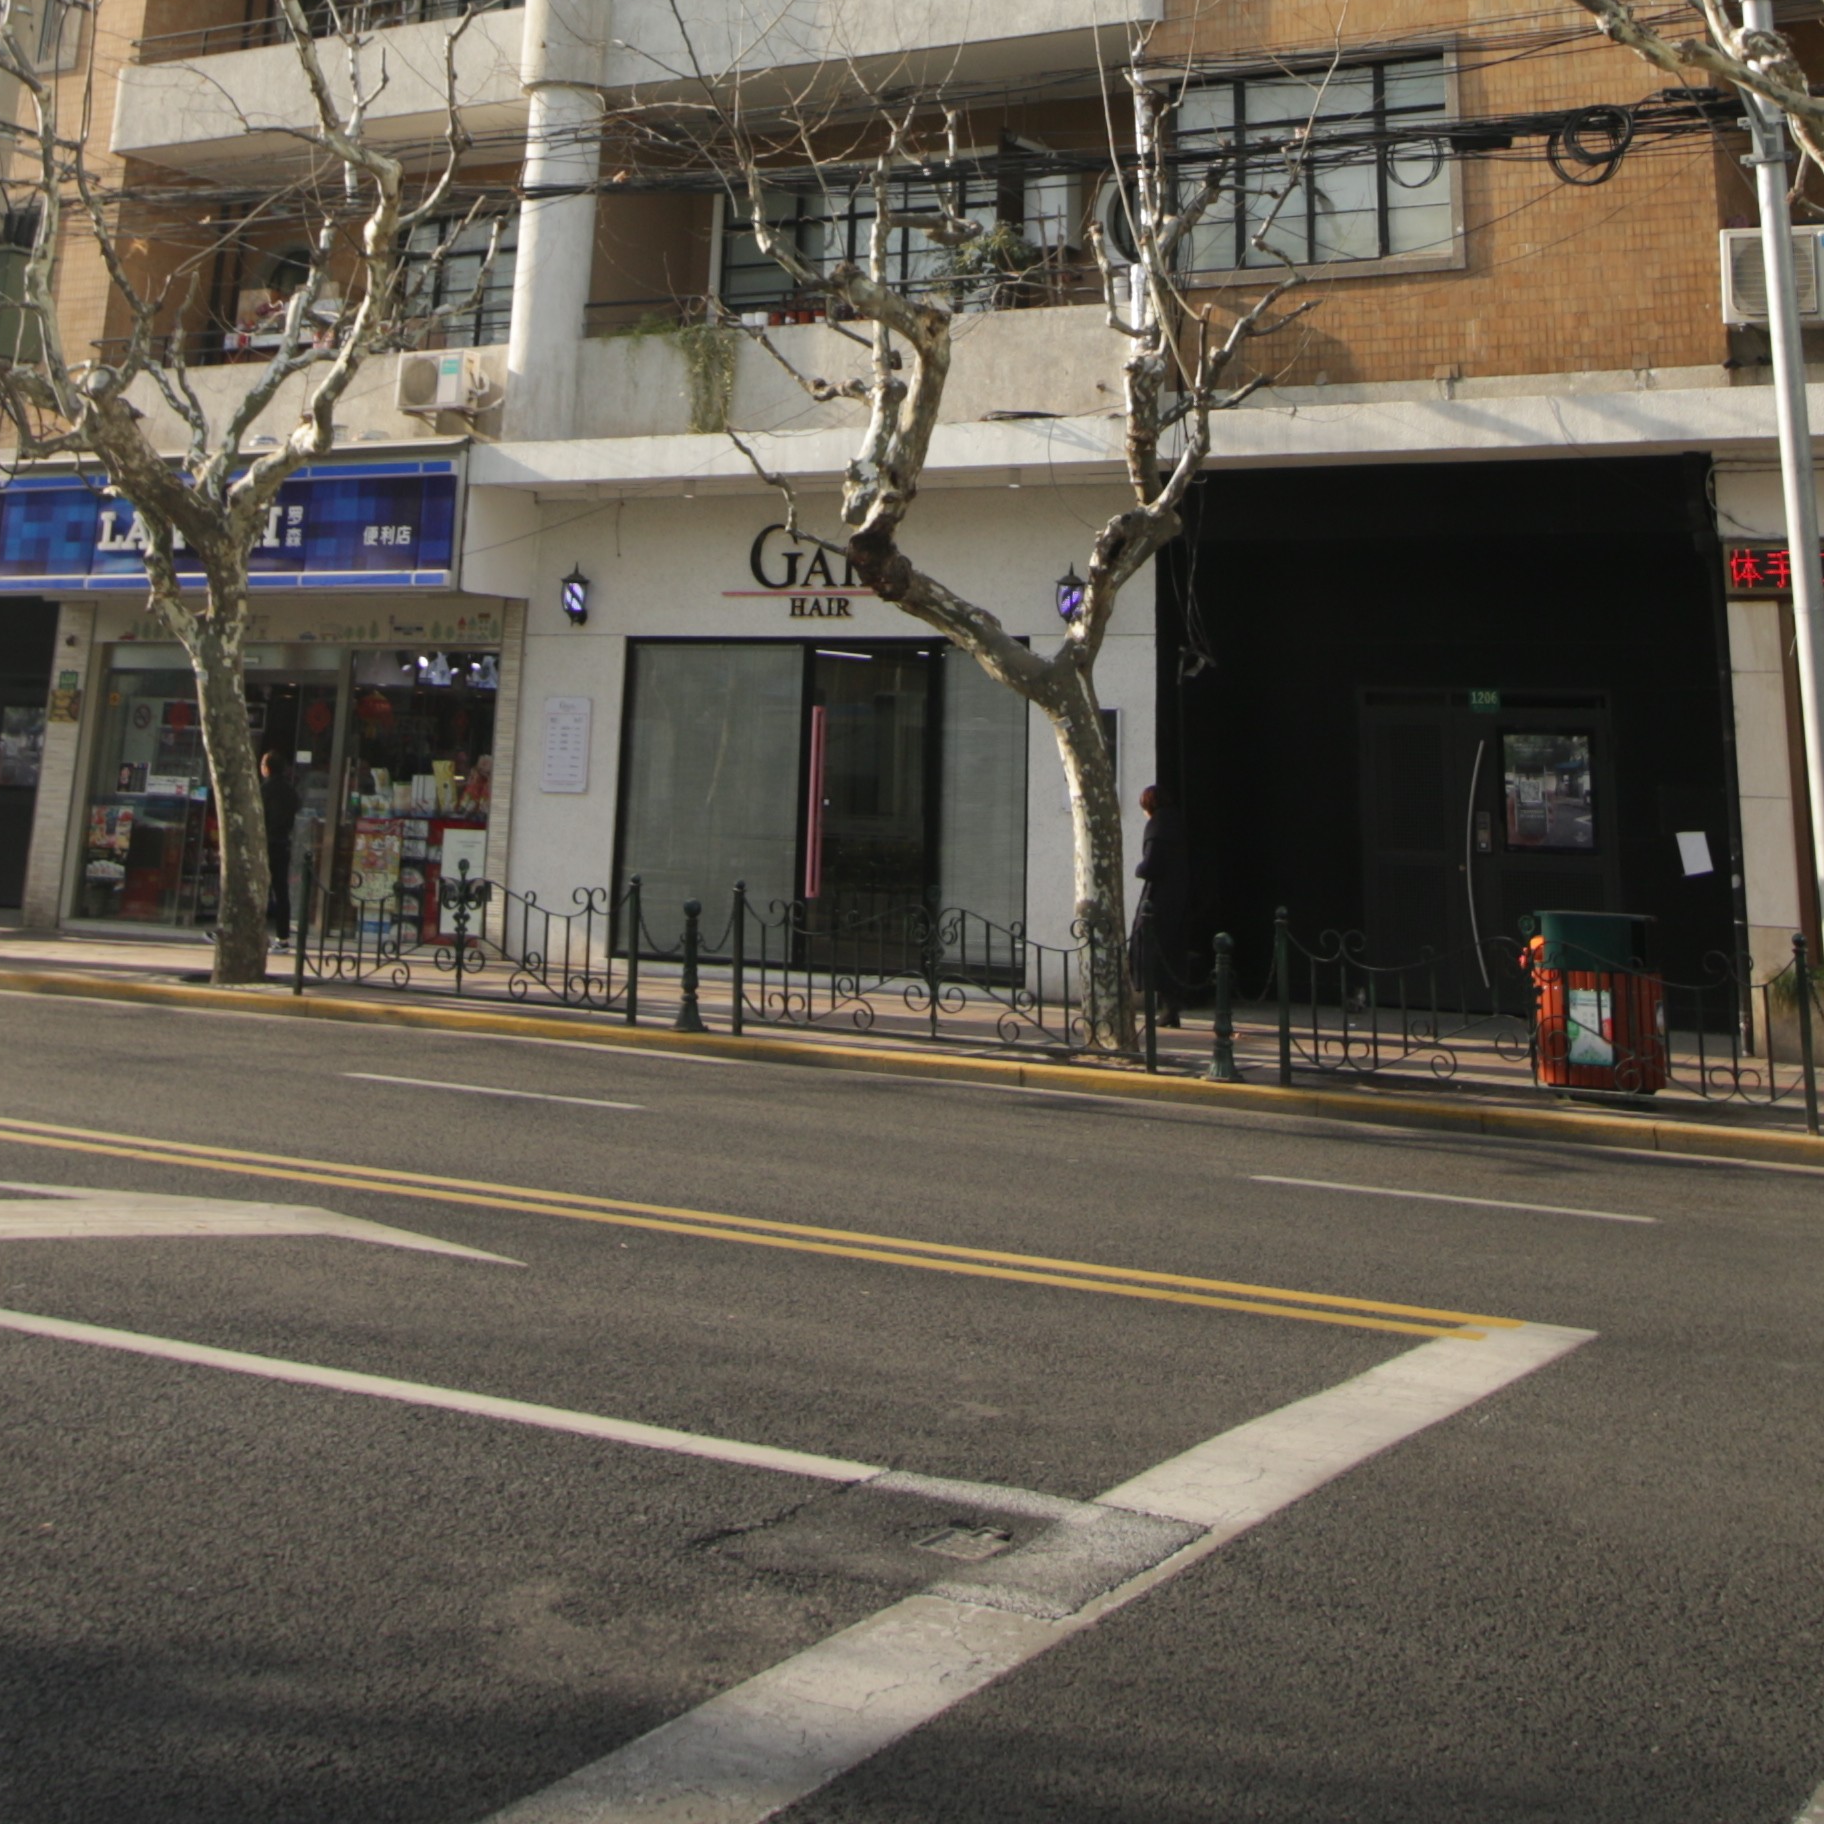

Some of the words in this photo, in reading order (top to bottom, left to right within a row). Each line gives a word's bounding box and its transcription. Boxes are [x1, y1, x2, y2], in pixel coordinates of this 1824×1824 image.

[285, 505, 304, 547] 罗森
[363, 525, 412, 546] 便利店
[789, 597, 853, 617] HAIR
[1471, 691, 1498, 704] 1206
